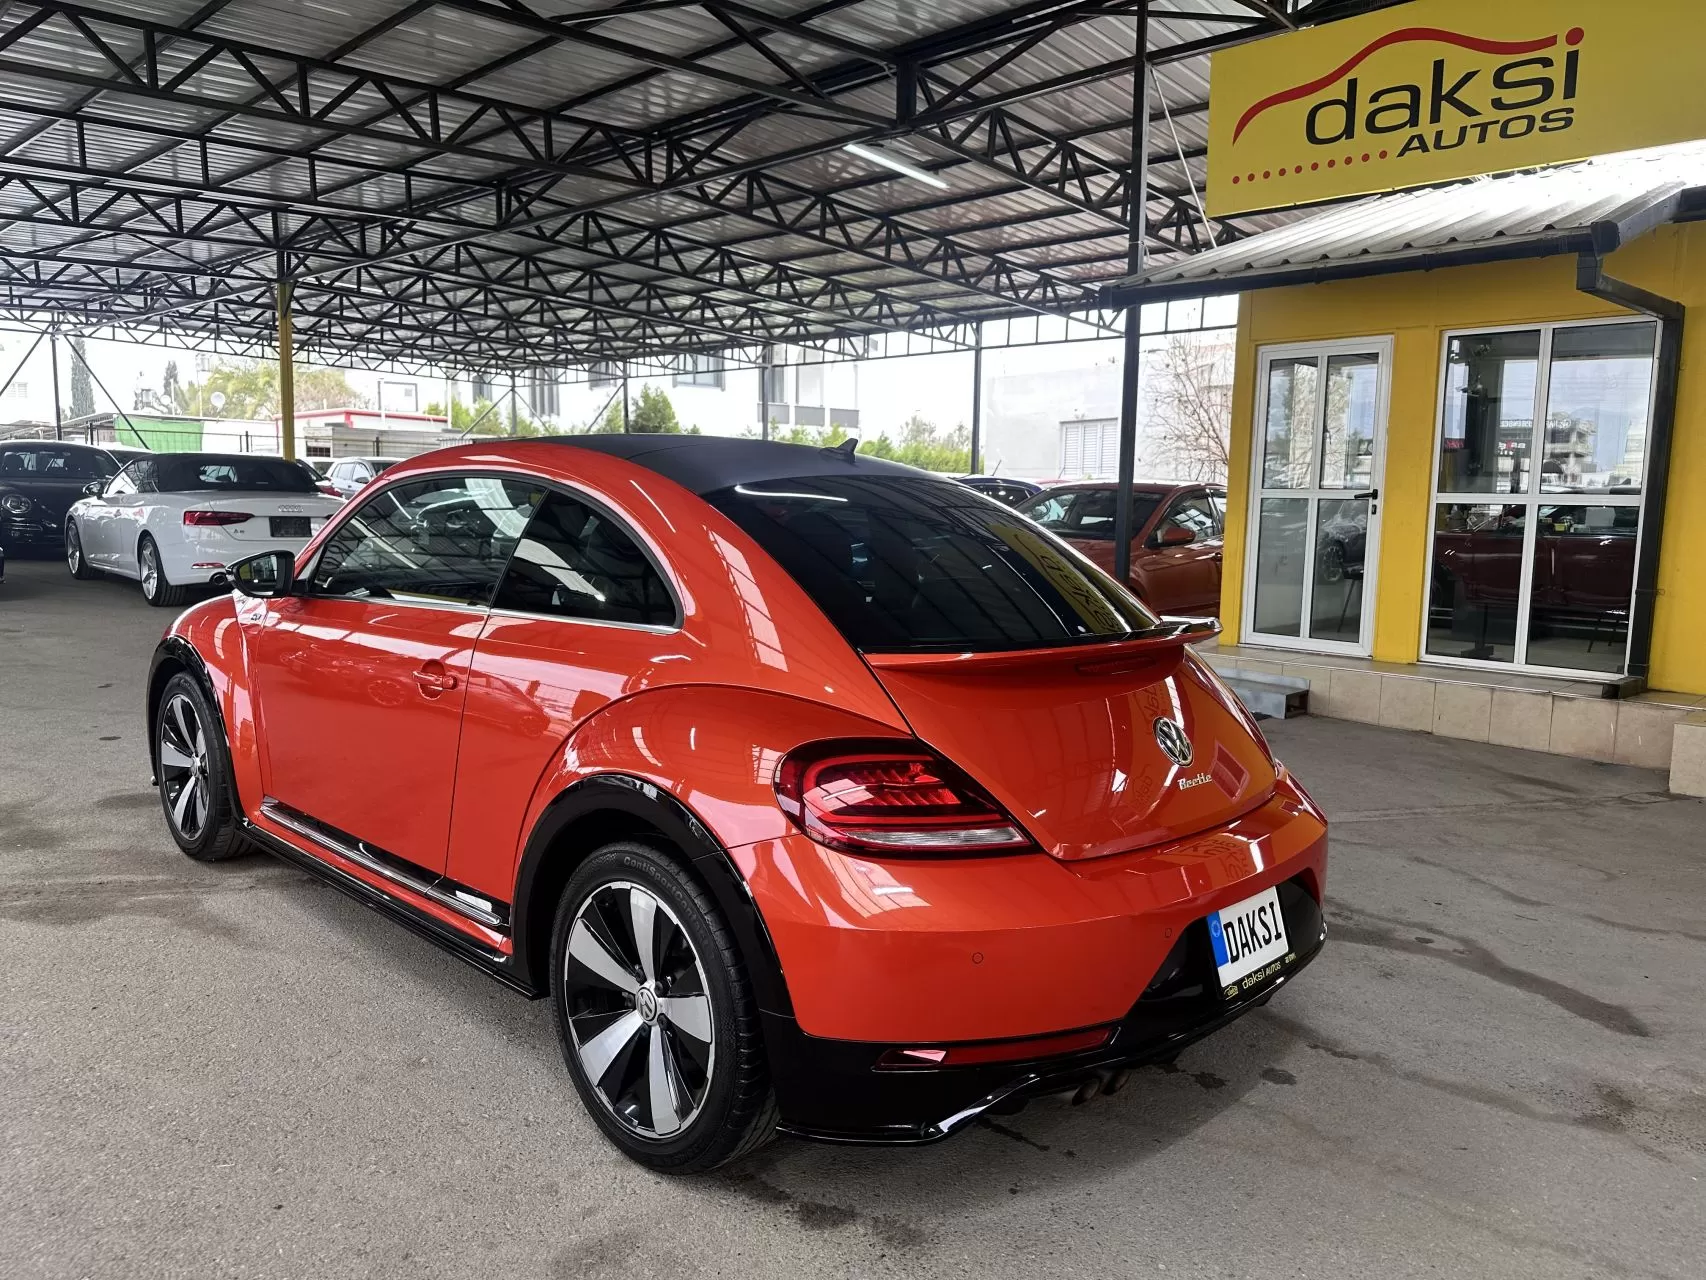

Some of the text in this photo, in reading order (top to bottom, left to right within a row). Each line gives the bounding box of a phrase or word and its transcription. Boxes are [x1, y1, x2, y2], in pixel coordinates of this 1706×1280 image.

[1305, 27, 1584, 146] daksi
[1397, 107, 1574, 158] AUTOS
[1177, 772, 1213, 791] Beetle
[1222, 900, 1282, 964] DAKSI
[1241, 968, 1266, 989] daksi
